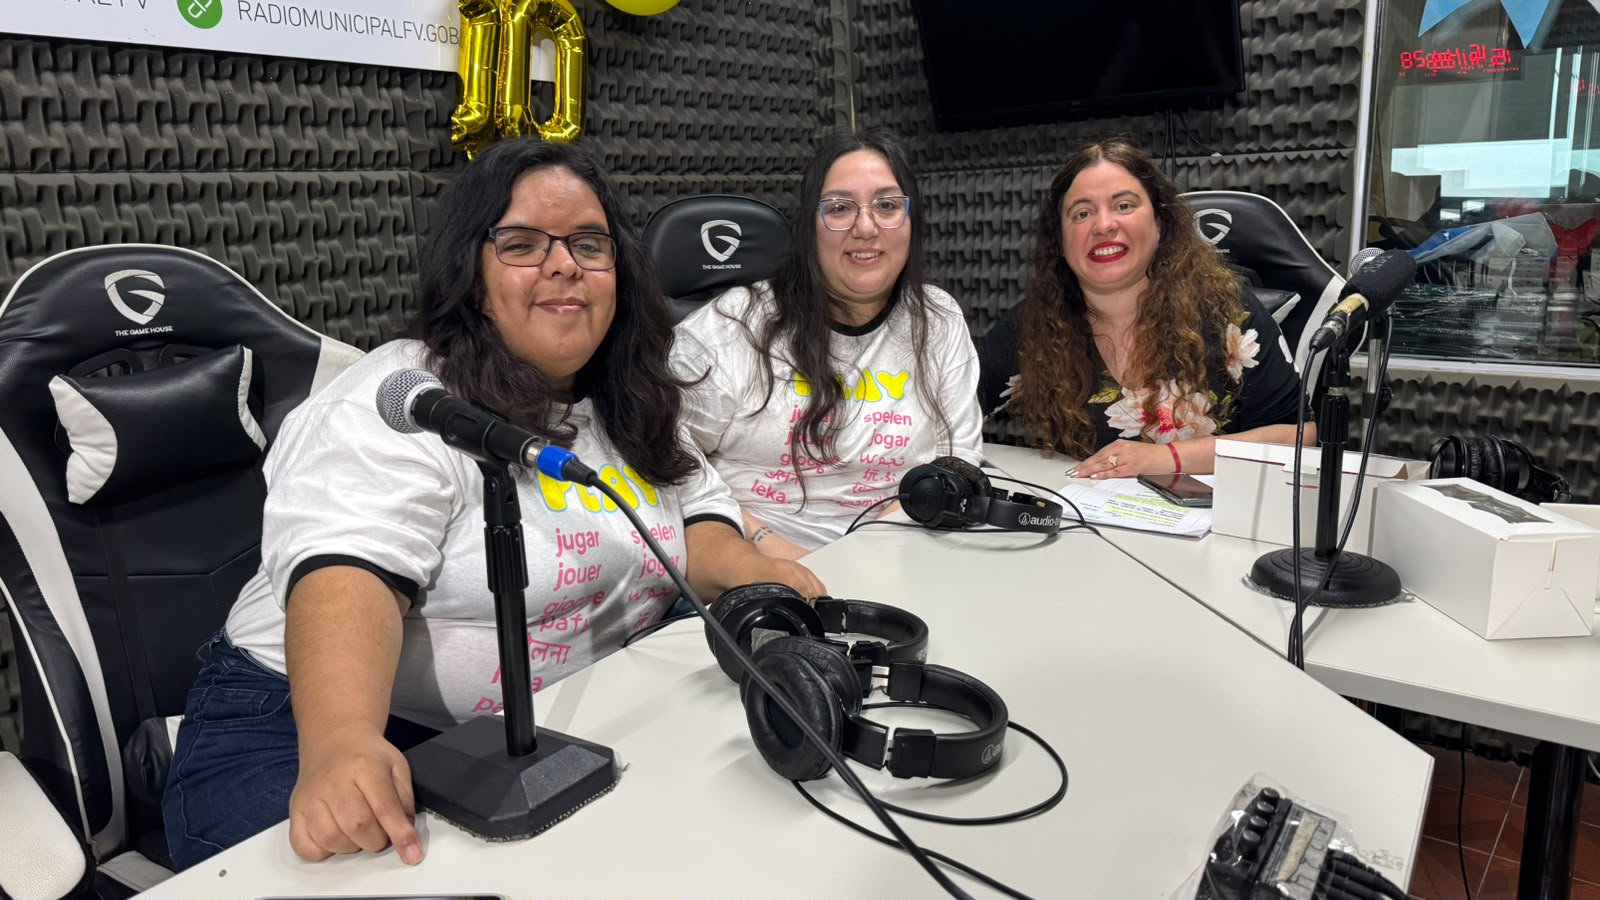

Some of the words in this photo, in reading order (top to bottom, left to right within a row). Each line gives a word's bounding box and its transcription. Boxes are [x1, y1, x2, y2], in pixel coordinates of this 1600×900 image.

[114, 329, 130, 337] THE
[129, 328, 150, 336] GAME
[149, 325, 174, 334] HOUSE
[863, 409, 913, 427] spelen
[868, 428, 910, 450] jogar
[555, 527, 600, 558] jugar
[553, 562, 603, 592] jouer
